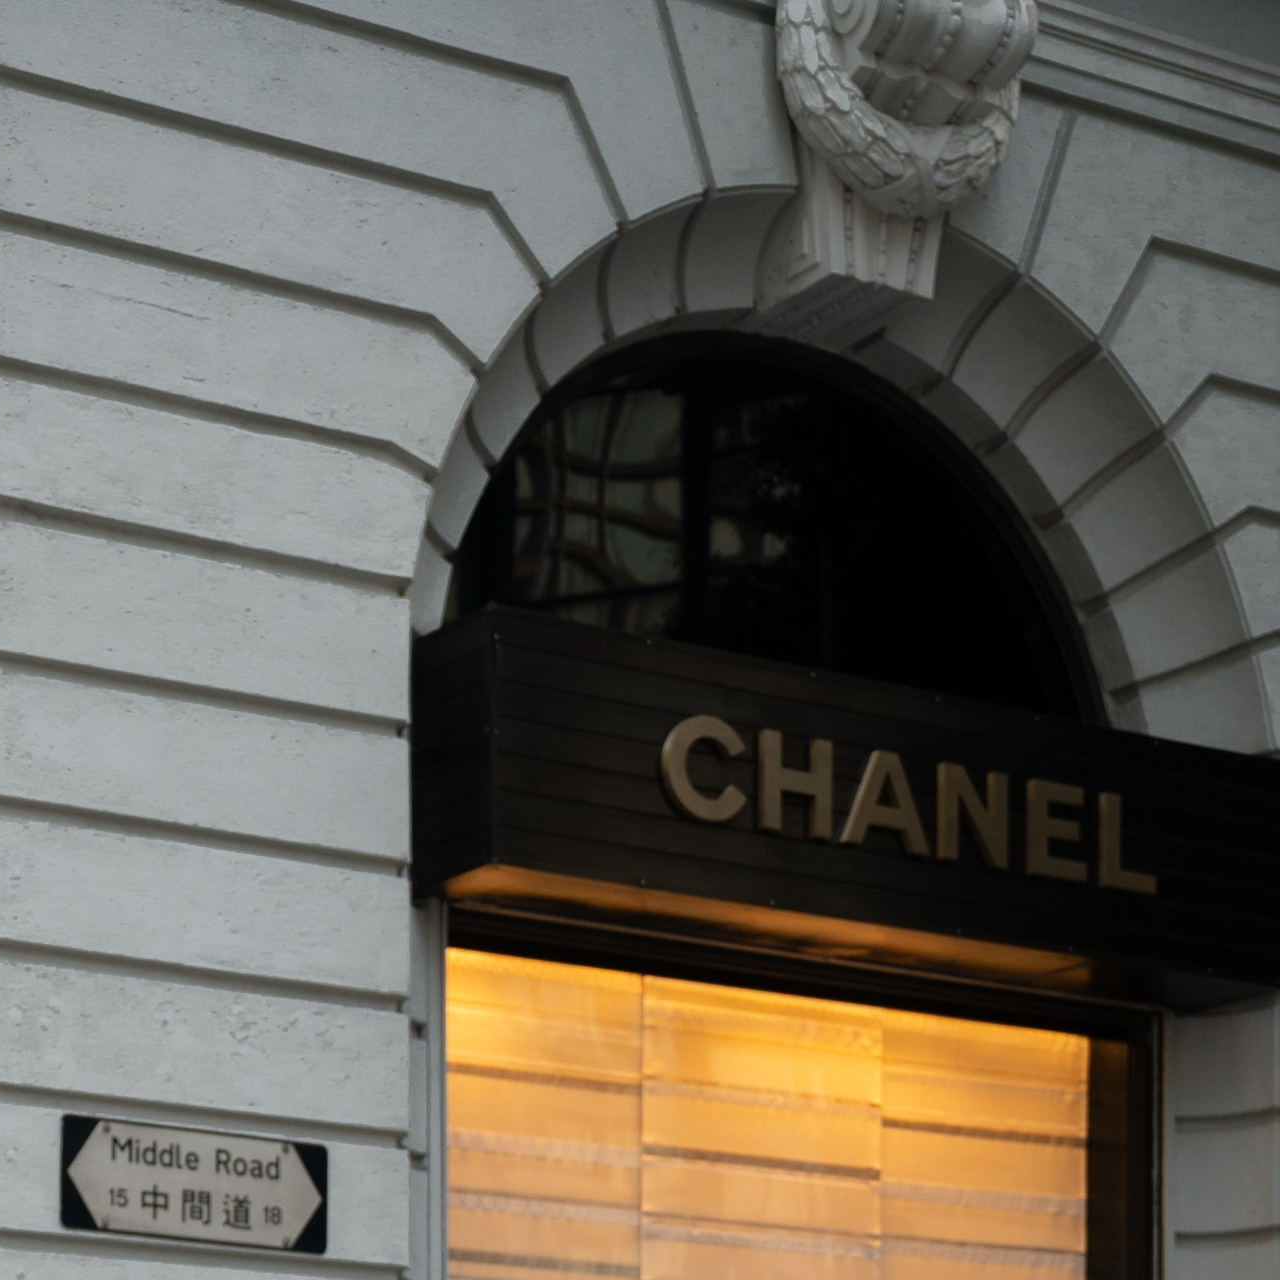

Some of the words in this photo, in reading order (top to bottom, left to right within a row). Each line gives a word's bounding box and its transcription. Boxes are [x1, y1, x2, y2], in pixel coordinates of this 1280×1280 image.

[661, 714, 1157, 894] CHANEL
[111, 1137, 200, 1171] Middle
[215, 1149, 281, 1181] Road
[109, 1188, 129, 1207] 15
[141, 1185, 252, 1231] 中間道
[263, 1206, 283, 1226] 18
